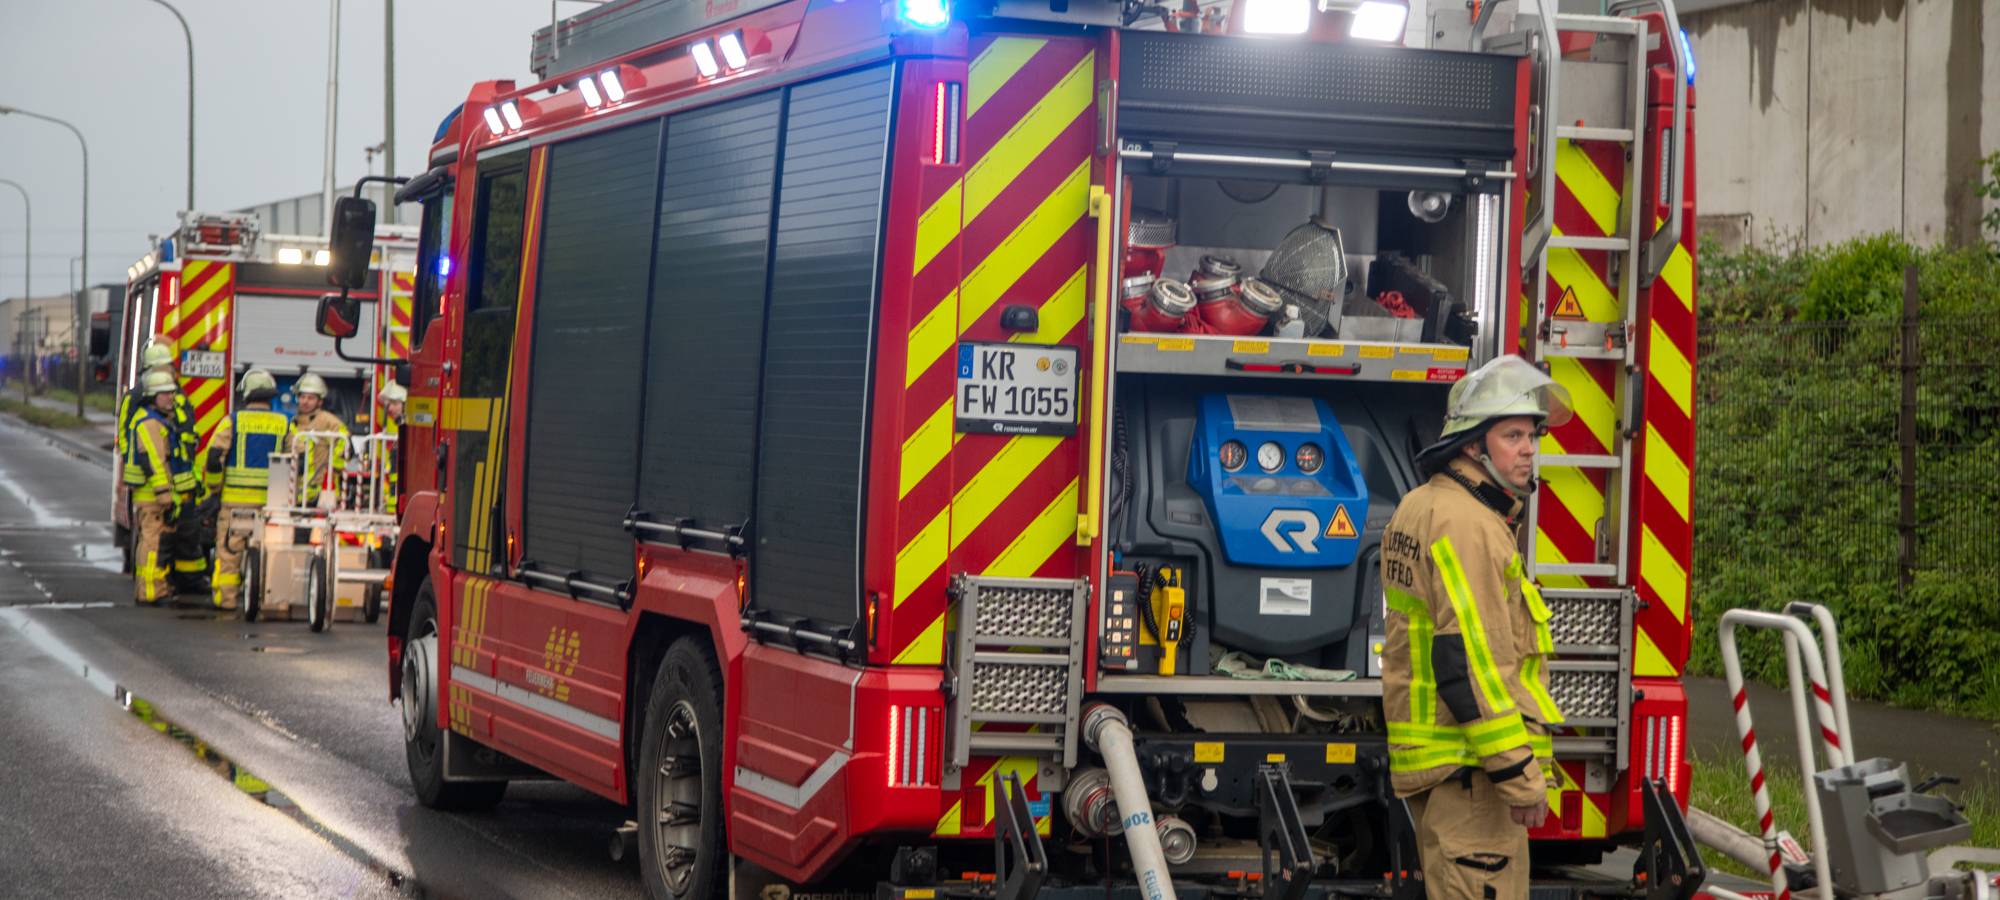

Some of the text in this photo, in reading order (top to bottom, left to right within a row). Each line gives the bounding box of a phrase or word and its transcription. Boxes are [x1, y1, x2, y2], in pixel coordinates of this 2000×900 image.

[962, 365, 970, 375] D
[982, 351, 1015, 380] KR
[963, 384, 1069, 416] FW 1055
